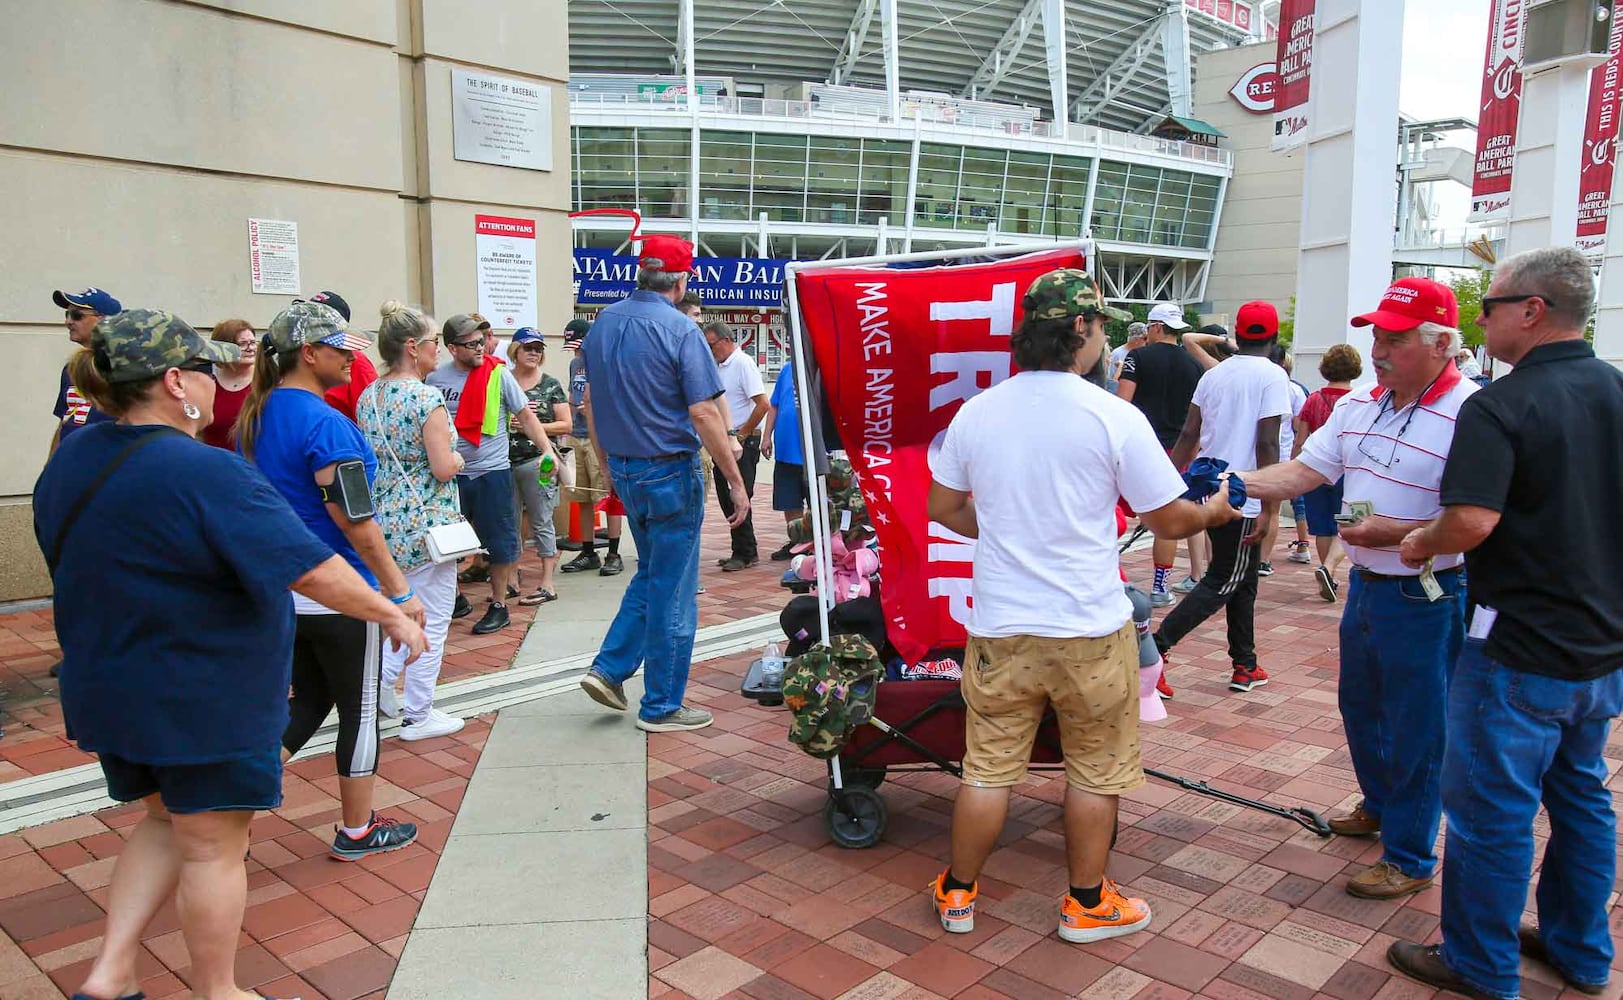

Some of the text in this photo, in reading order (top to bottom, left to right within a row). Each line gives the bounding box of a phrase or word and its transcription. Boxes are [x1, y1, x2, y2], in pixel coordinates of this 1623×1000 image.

[1604, 59, 1619, 89] REDS
[467, 78, 477, 88] THE
[480, 80, 498, 91] SPIRIT
[501, 84, 509, 93] OF
[512, 86, 539, 98] BASEBALL
[1248, 81, 1276, 96] RE
[1603, 90, 1615, 102] IS
[1599, 103, 1612, 131] THIS
[1486, 135, 1512, 149] GREAT
[1479, 145, 1516, 161] AMERICAN
[1476, 157, 1514, 172] BALL PAR
[1584, 191, 1606, 202] GREAT
[479, 221, 533, 233] ATTENTION FANS
[250, 220, 261, 281] ALCOHOL POLICY
[584, 289, 630, 299] Presented by
[1390, 294, 1413, 304] AGAIN
[734, 315, 751, 324] WAY
[854, 281, 893, 361] MAKE
[863, 367, 894, 469] AMERICA
[961, 907, 970, 916] DO
